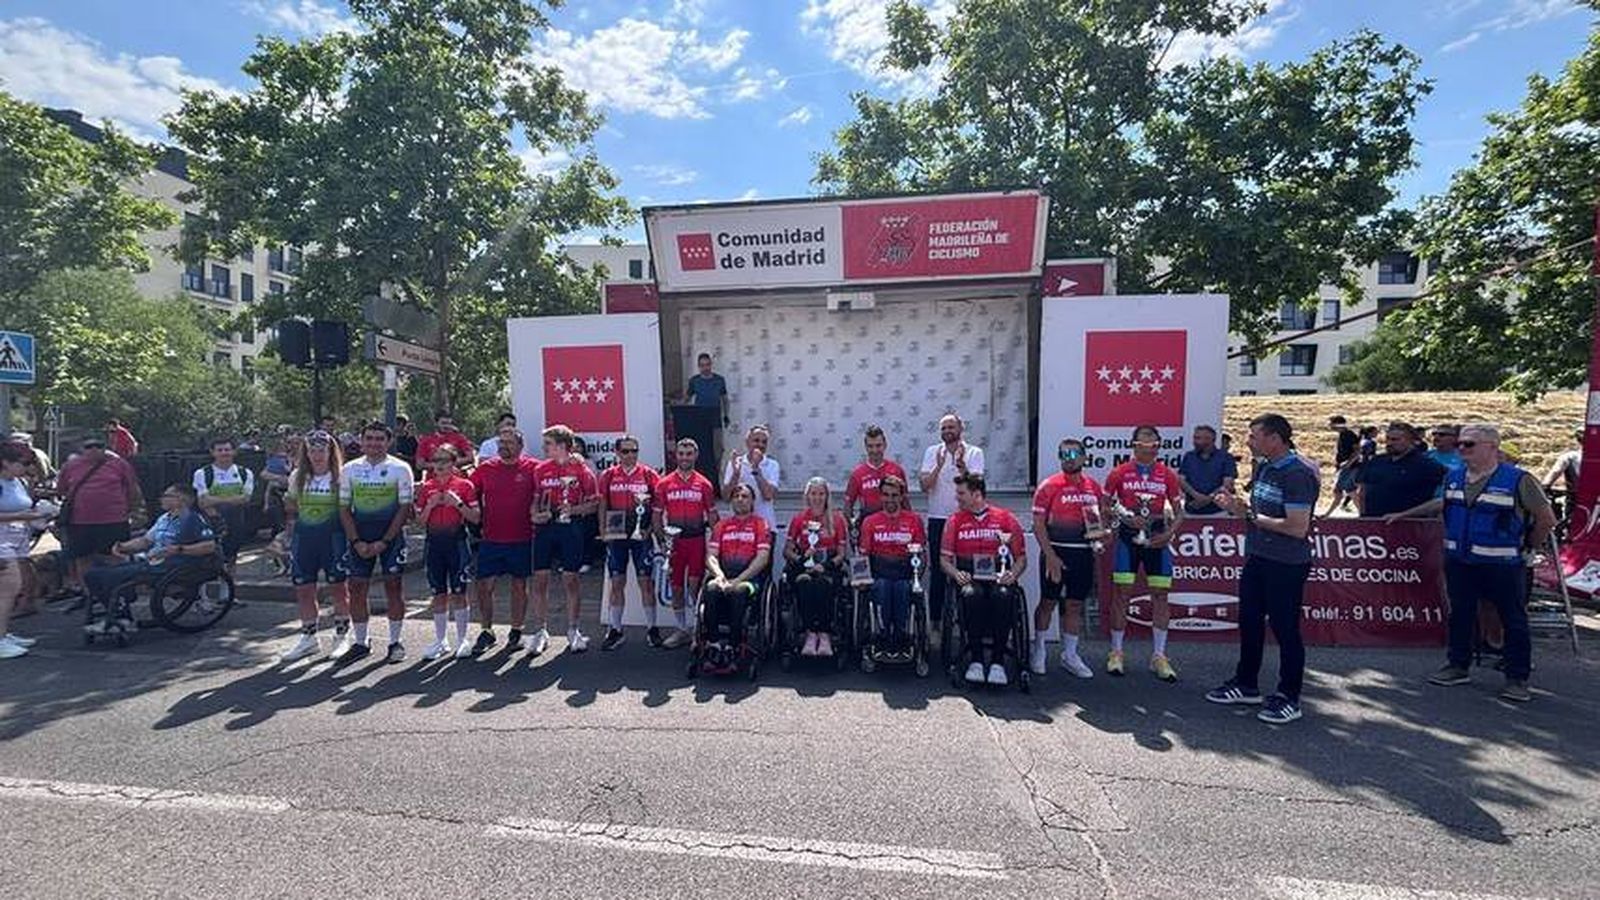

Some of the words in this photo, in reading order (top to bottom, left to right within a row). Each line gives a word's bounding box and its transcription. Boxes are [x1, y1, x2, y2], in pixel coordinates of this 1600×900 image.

[929, 217, 998, 235] FEDERACIÓN
[717, 227, 825, 248] Comunidad
[928, 232, 993, 247] MADRILEÑA
[995, 232, 1010, 244] DE
[720, 254, 746, 270] de
[753, 249, 825, 268] Madrid
[928, 247, 980, 260] CICLISMO
[1123, 481, 1168, 494] MADRID
[1330, 569, 1354, 583] DE
[1356, 568, 1422, 583] COCINA
[1352, 605, 1374, 621] 91
[1382, 606, 1415, 621] 604
[1422, 607, 1443, 622] 11
